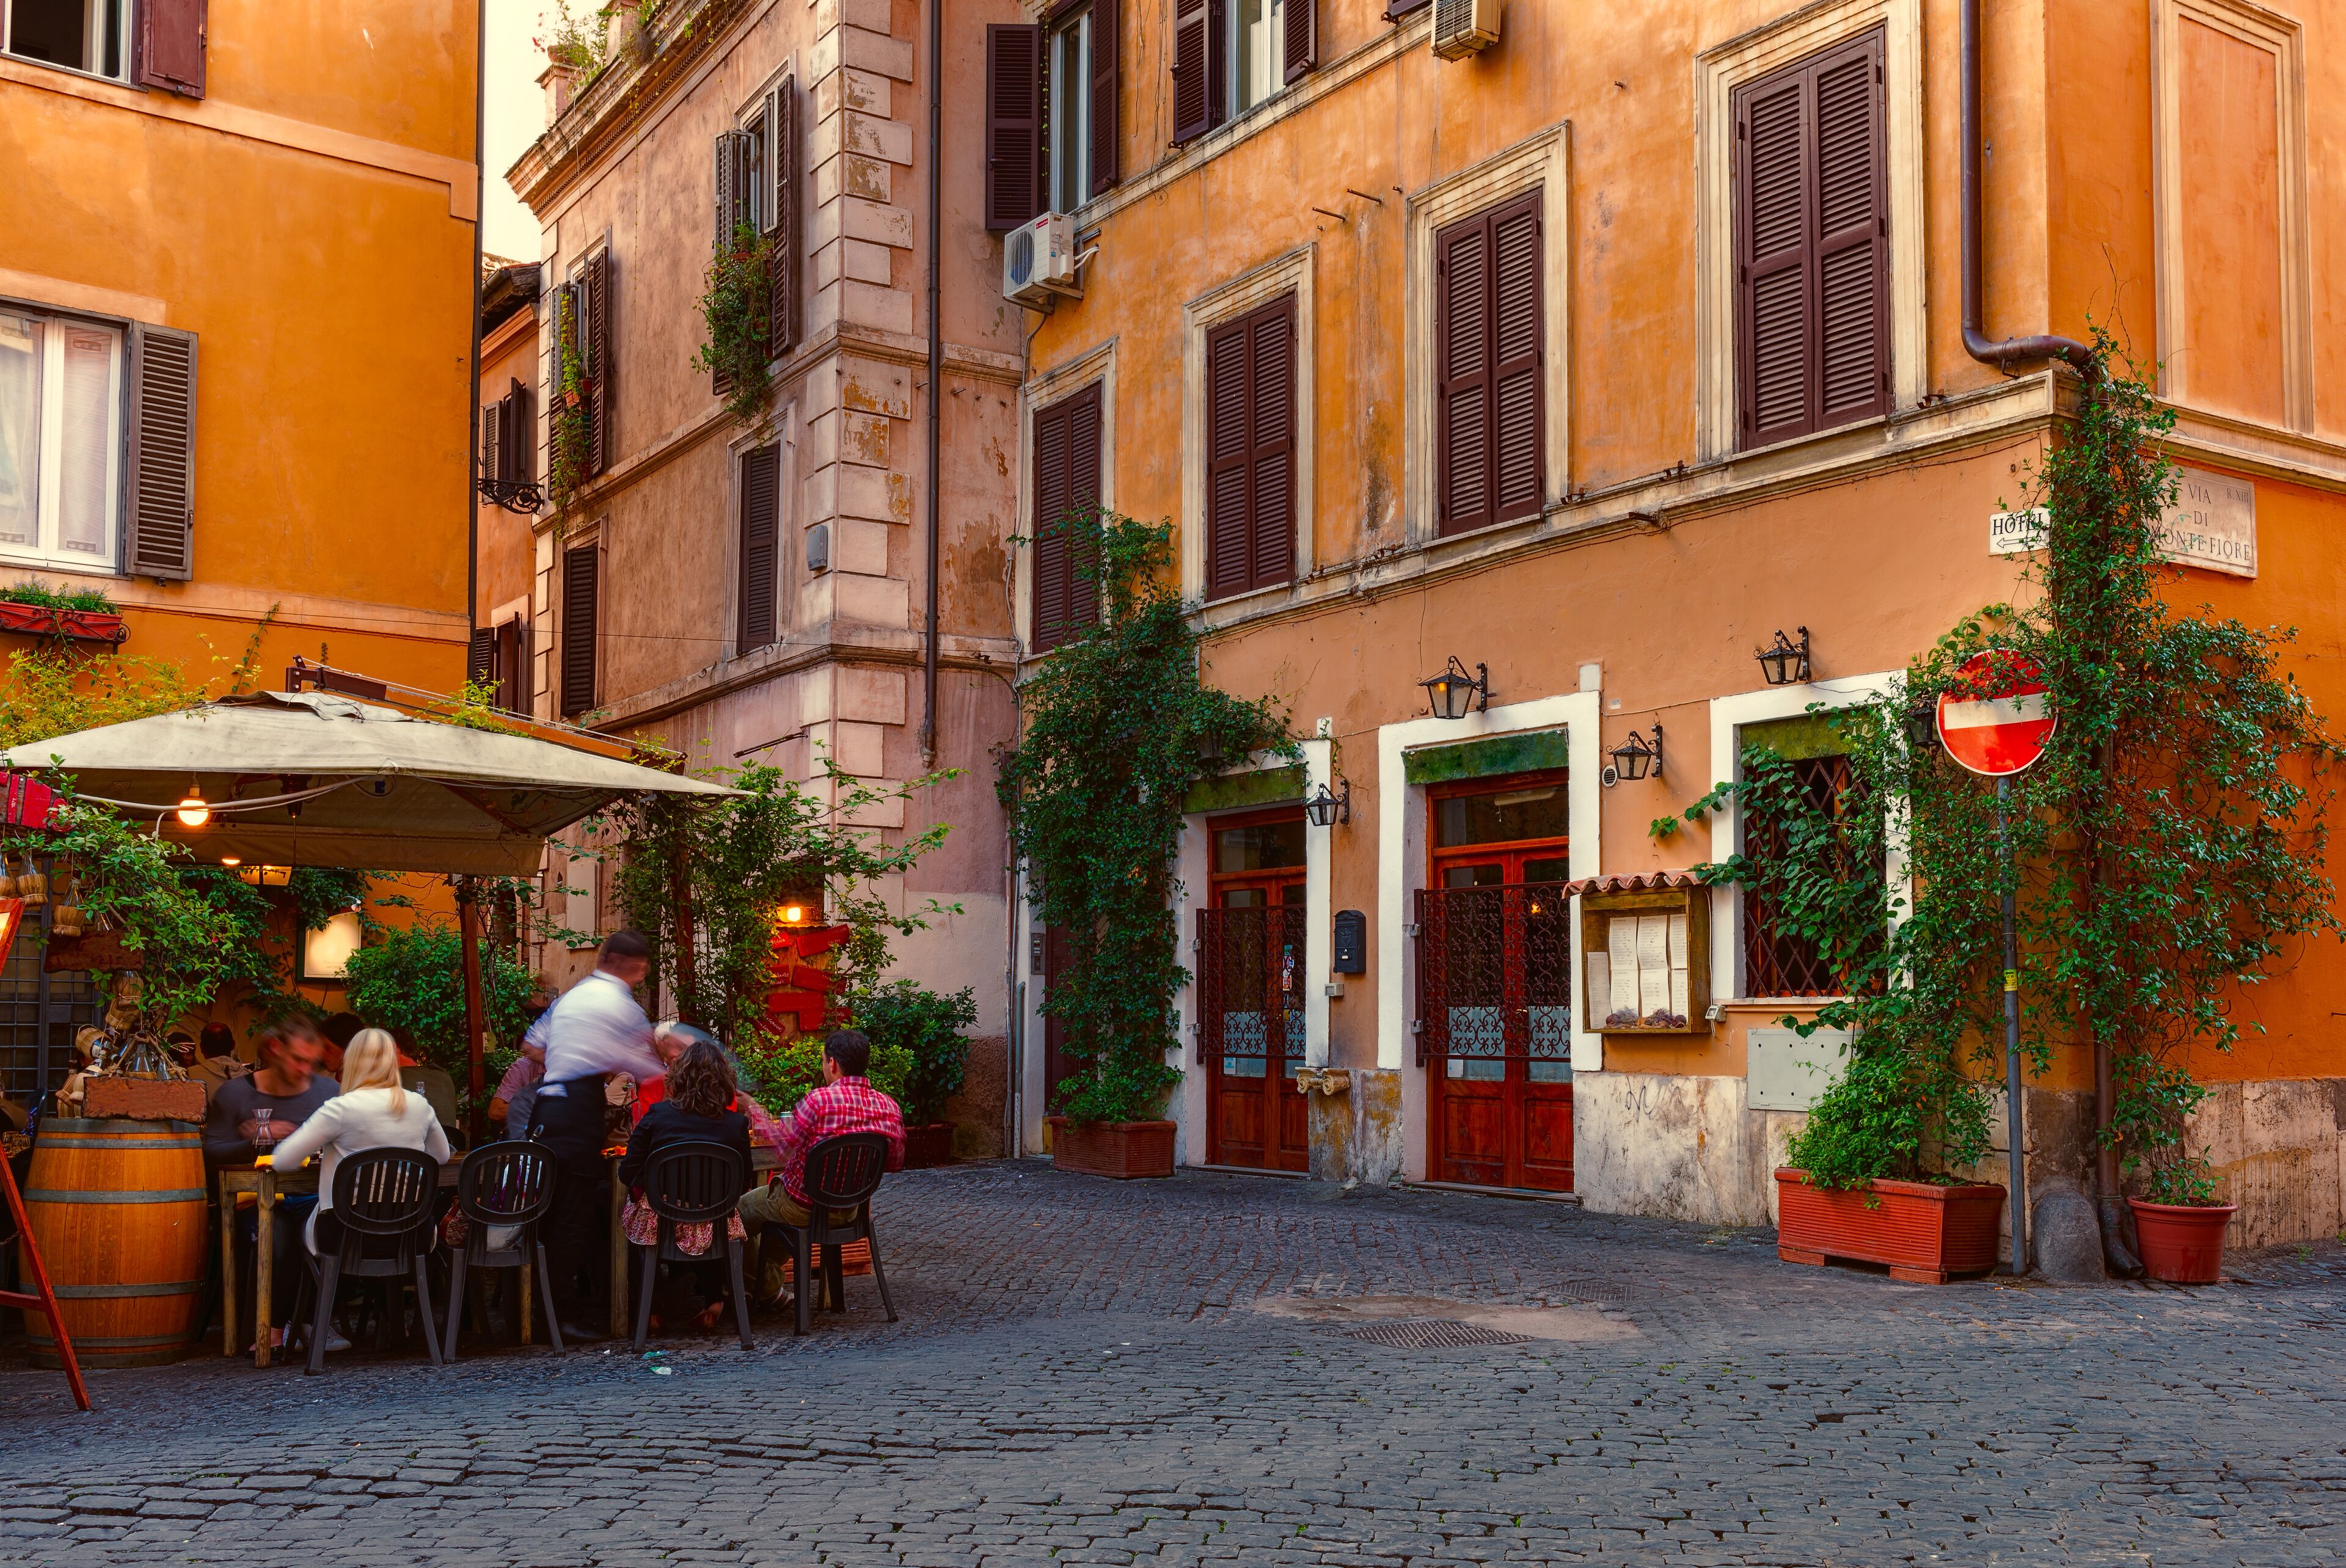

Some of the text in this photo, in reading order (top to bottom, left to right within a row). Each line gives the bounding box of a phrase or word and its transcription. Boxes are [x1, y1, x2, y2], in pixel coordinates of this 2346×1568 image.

[2188, 483, 2212, 504] VIA
[2193, 511, 2208, 526] DI
[2209, 537, 2250, 561] FIORE
